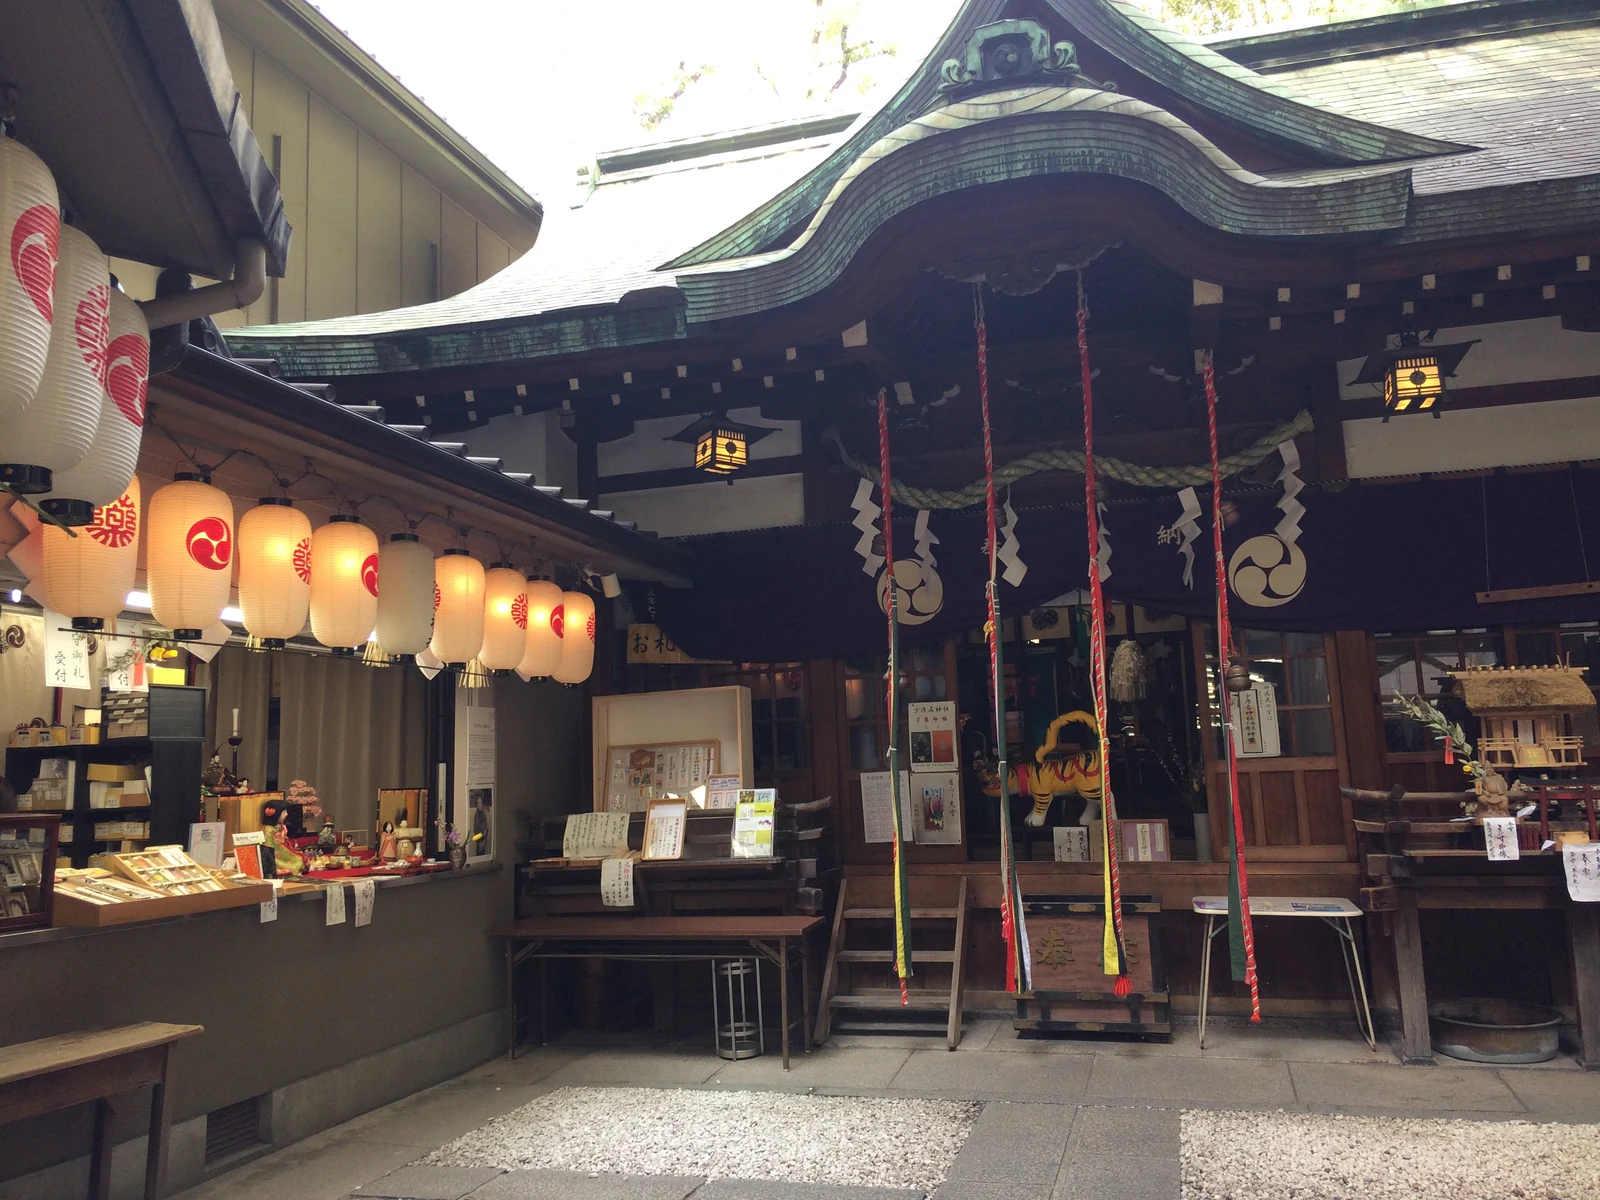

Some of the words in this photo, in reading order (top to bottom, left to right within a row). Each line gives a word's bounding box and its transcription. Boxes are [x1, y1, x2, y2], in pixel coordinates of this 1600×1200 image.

[1156, 524, 1181, 546] 納
[632, 631, 677, 655] お札
[54, 650, 67, 683] 受付
